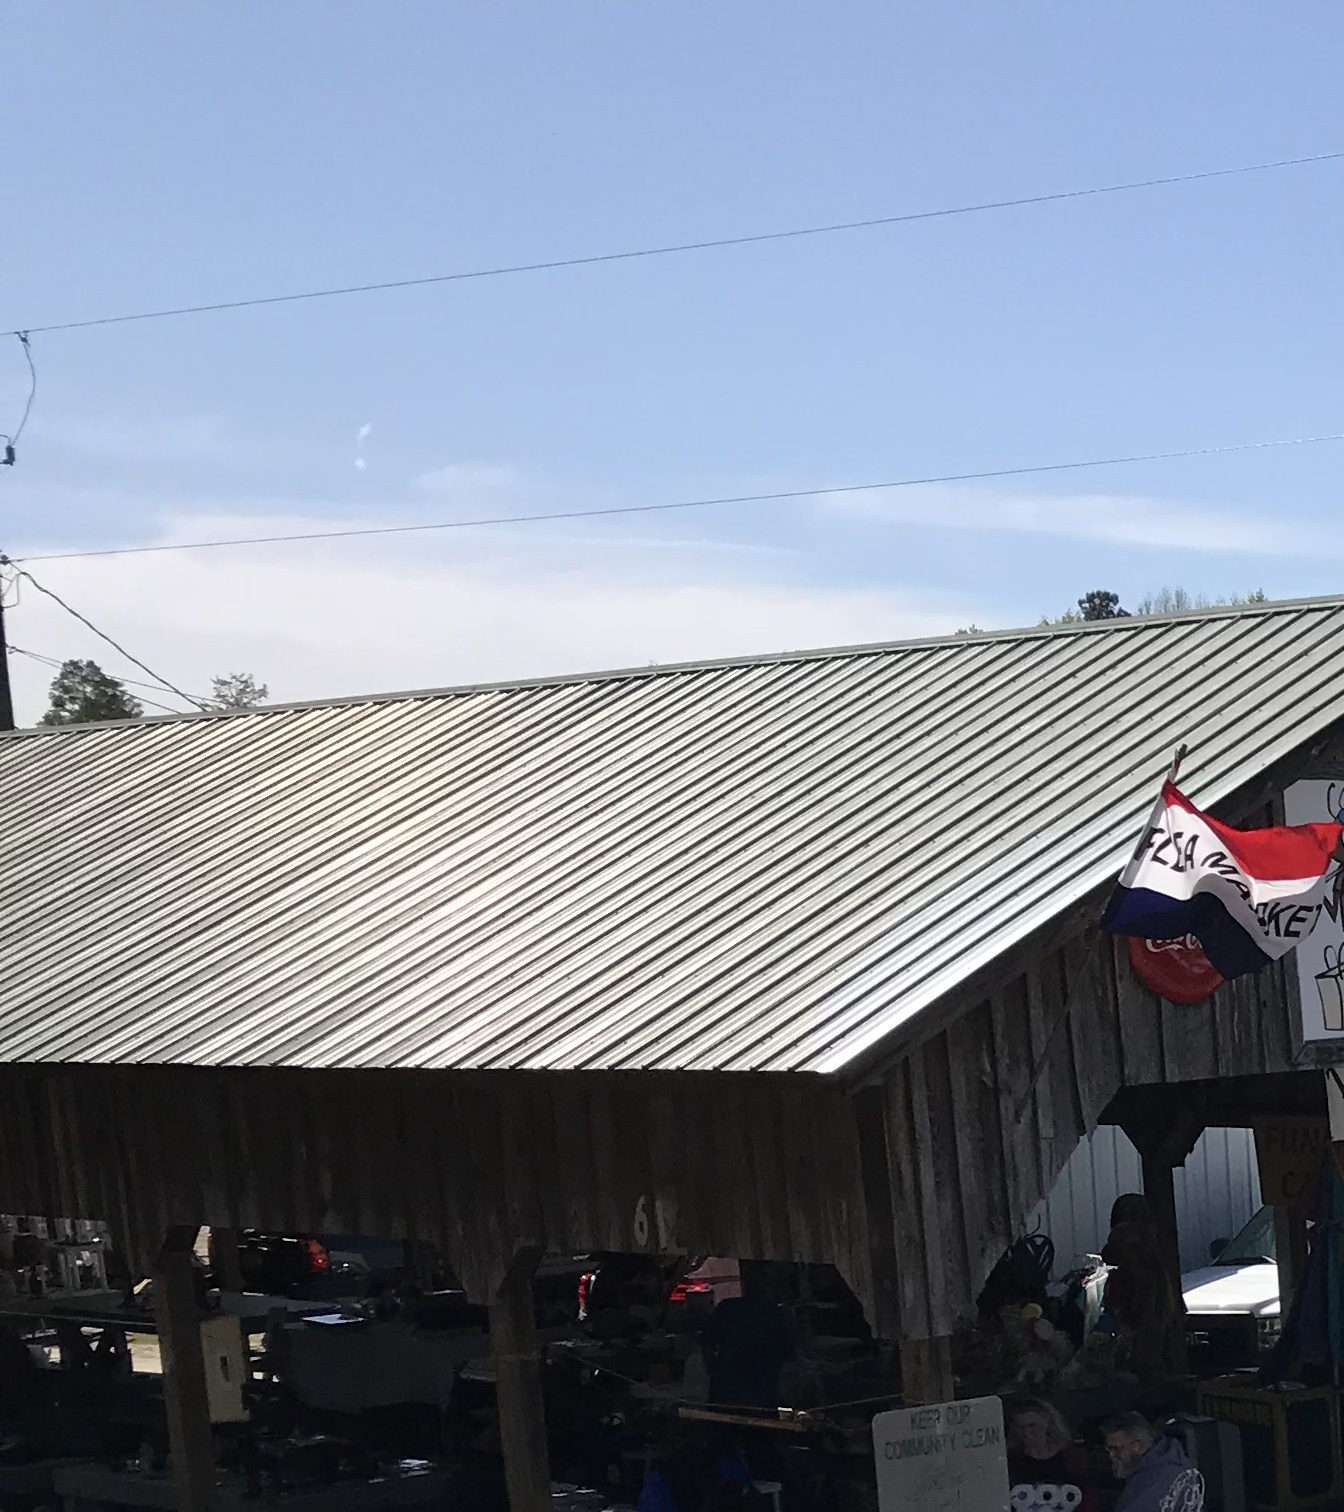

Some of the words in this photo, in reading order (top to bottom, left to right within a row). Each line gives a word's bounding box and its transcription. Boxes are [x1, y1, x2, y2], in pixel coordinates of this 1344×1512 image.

[1133, 827, 1200, 872] FLEA
[885, 1431, 956, 1461] COMMUNITY
[962, 1424, 1001, 1449] CLEAN
